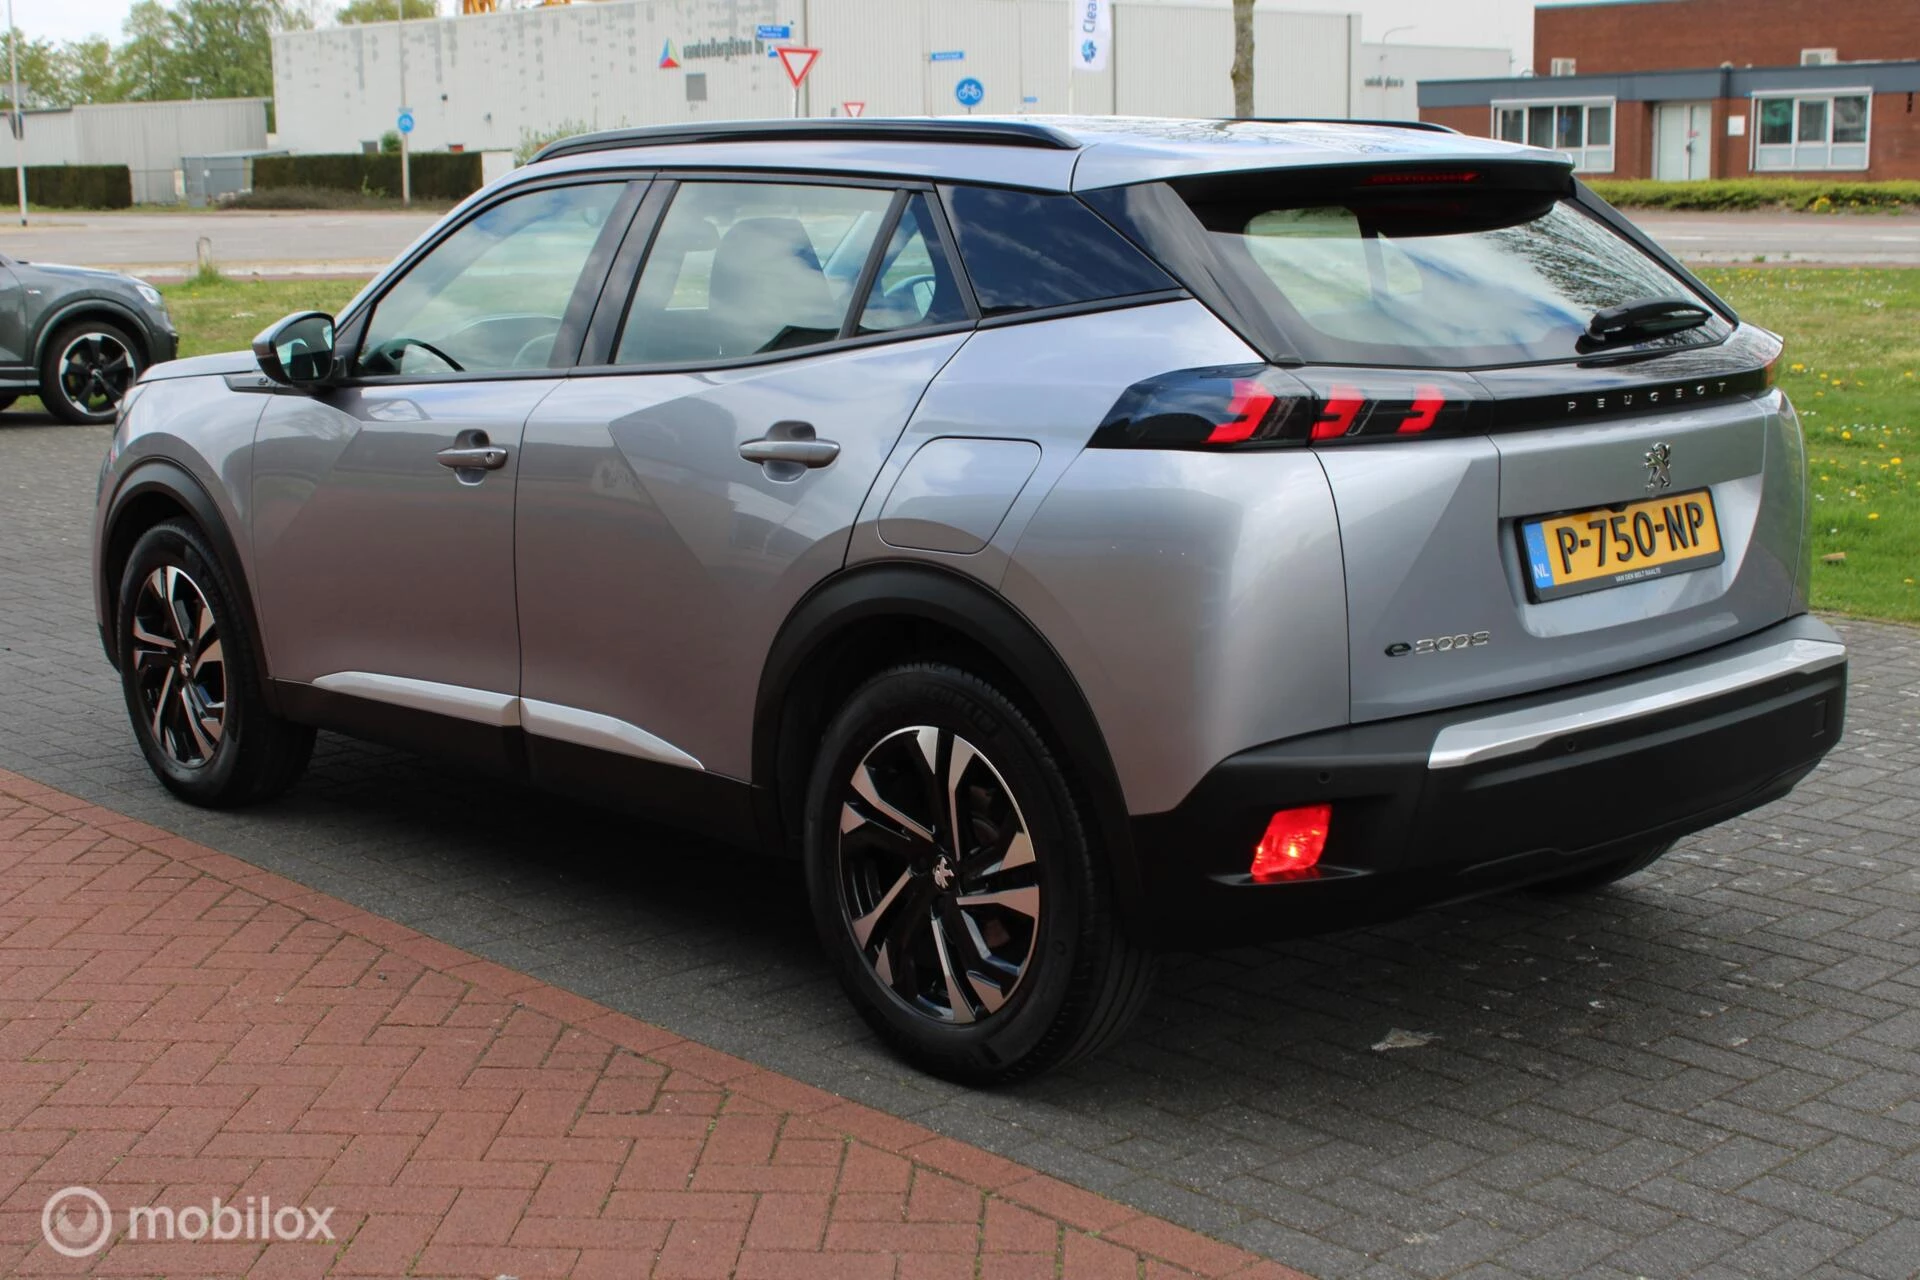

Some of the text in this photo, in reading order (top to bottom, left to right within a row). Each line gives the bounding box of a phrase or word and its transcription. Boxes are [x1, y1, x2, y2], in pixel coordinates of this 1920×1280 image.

[1082, 0, 1097, 33] Clea
[1567, 383, 1726, 411] PEUGEOT
[1557, 503, 1704, 574] P-750-NP
[1533, 563, 1550, 579] NL
